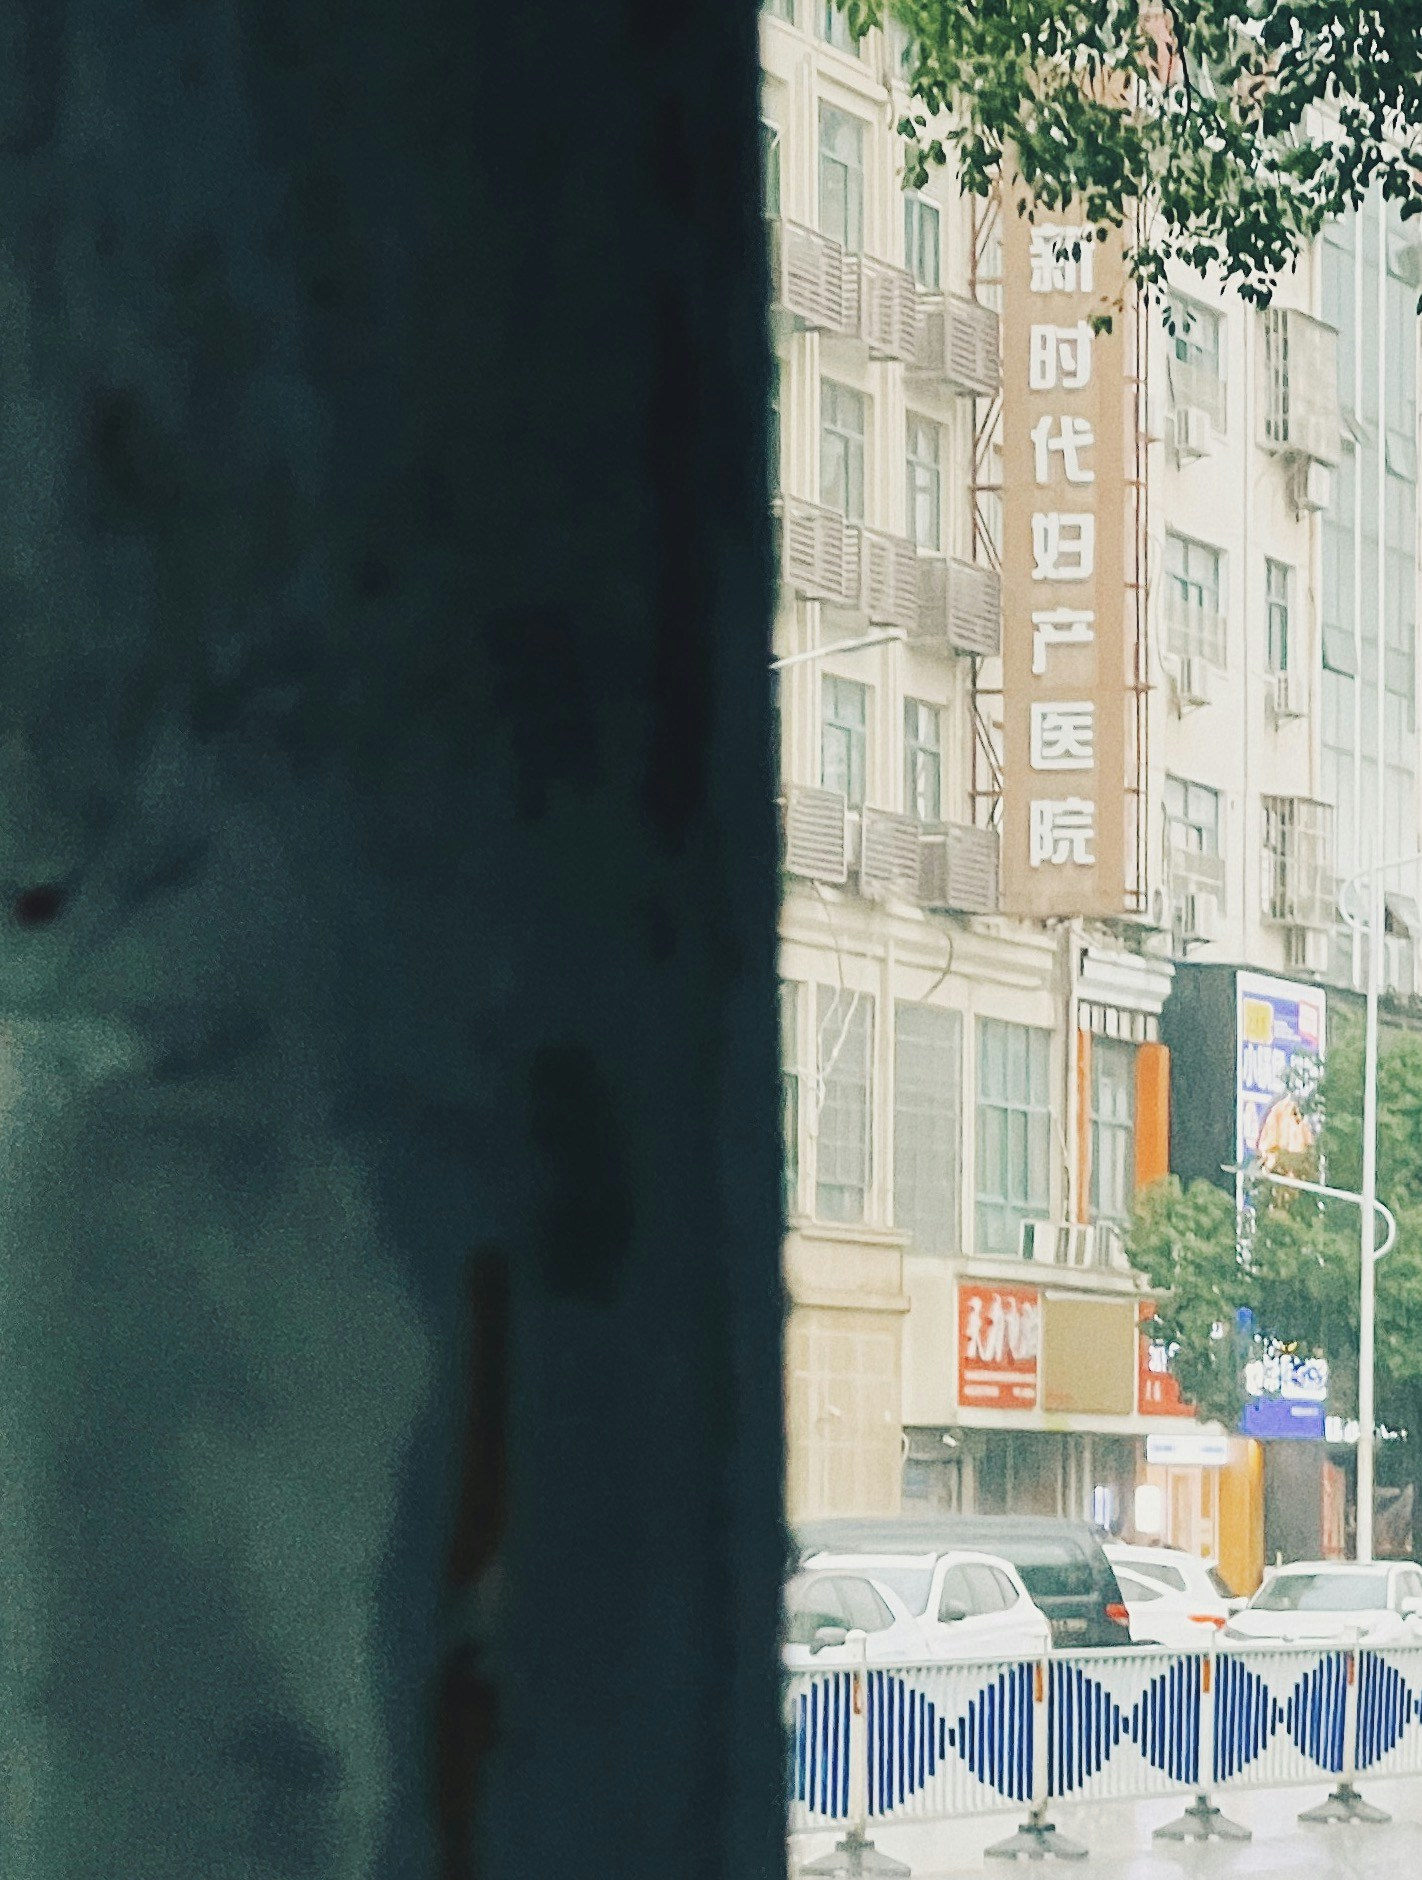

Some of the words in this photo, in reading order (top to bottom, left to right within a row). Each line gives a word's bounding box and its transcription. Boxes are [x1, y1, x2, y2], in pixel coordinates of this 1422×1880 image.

[1029, 222, 1096, 867] 新时代妇产医院
